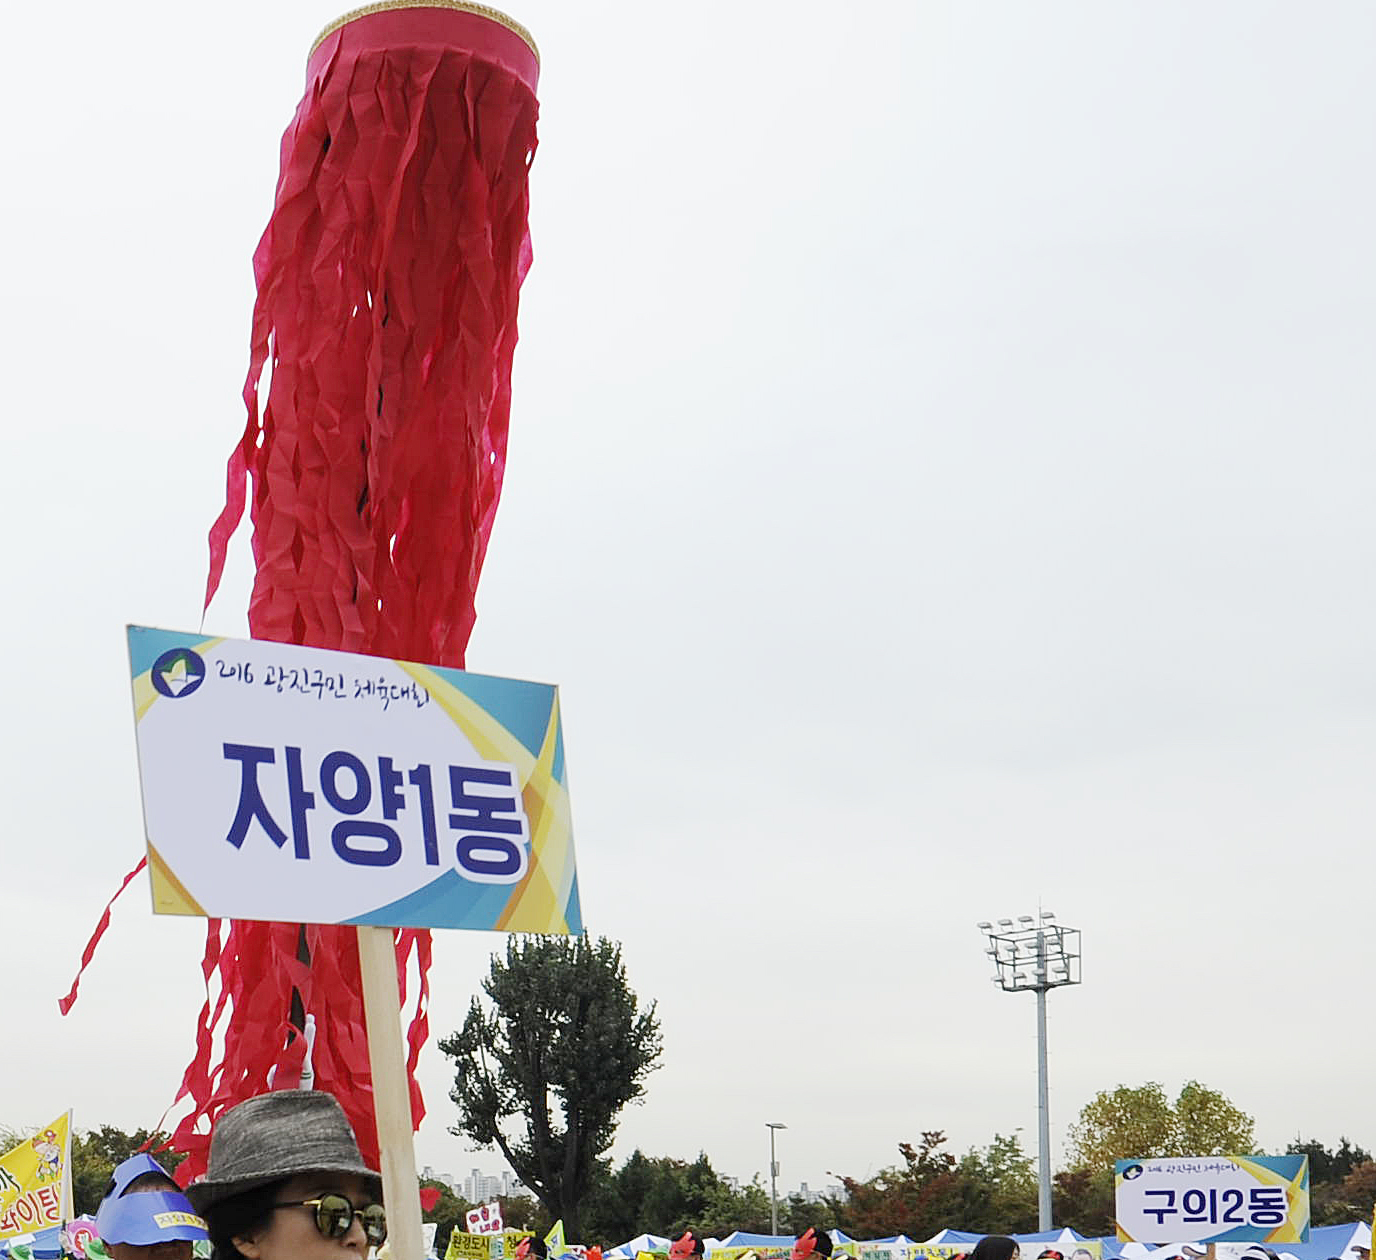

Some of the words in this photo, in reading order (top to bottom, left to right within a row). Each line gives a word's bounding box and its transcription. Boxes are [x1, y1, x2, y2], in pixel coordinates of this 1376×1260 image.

[215, 659, 254, 684] 2016
[264, 665, 346, 701] 광진구민
[354, 677, 431, 712] 체육대회
[222, 742, 523, 876] 자양1동
[1143, 1188, 1286, 1225] 구의2동
